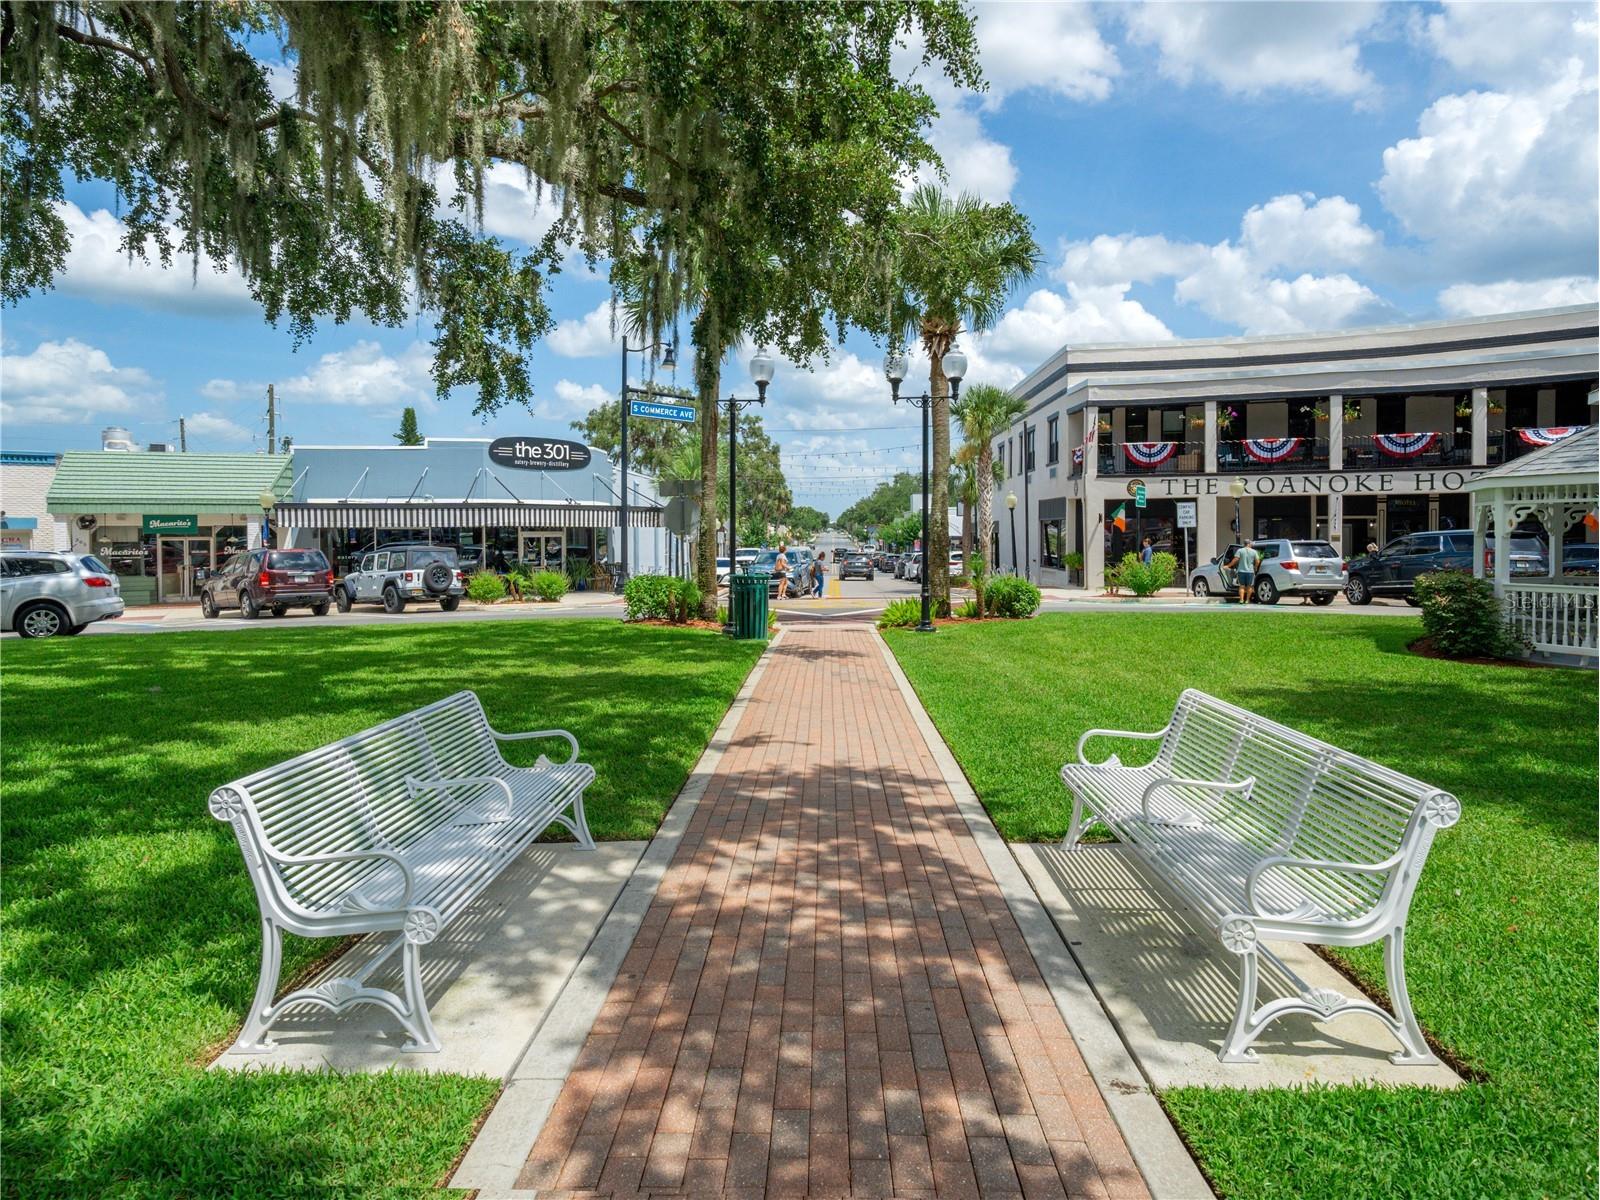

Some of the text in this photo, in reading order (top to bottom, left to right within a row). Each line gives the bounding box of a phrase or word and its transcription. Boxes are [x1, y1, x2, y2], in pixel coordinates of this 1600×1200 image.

[633, 404, 693, 419] S COMMERCE AVE
[515, 441, 570, 460] the 301
[1161, 478, 1218, 496] THE
[1237, 474, 1394, 494] ROANOKE
[149, 518, 192, 528] Macarito's
[100, 546, 149, 556] Macarito's
